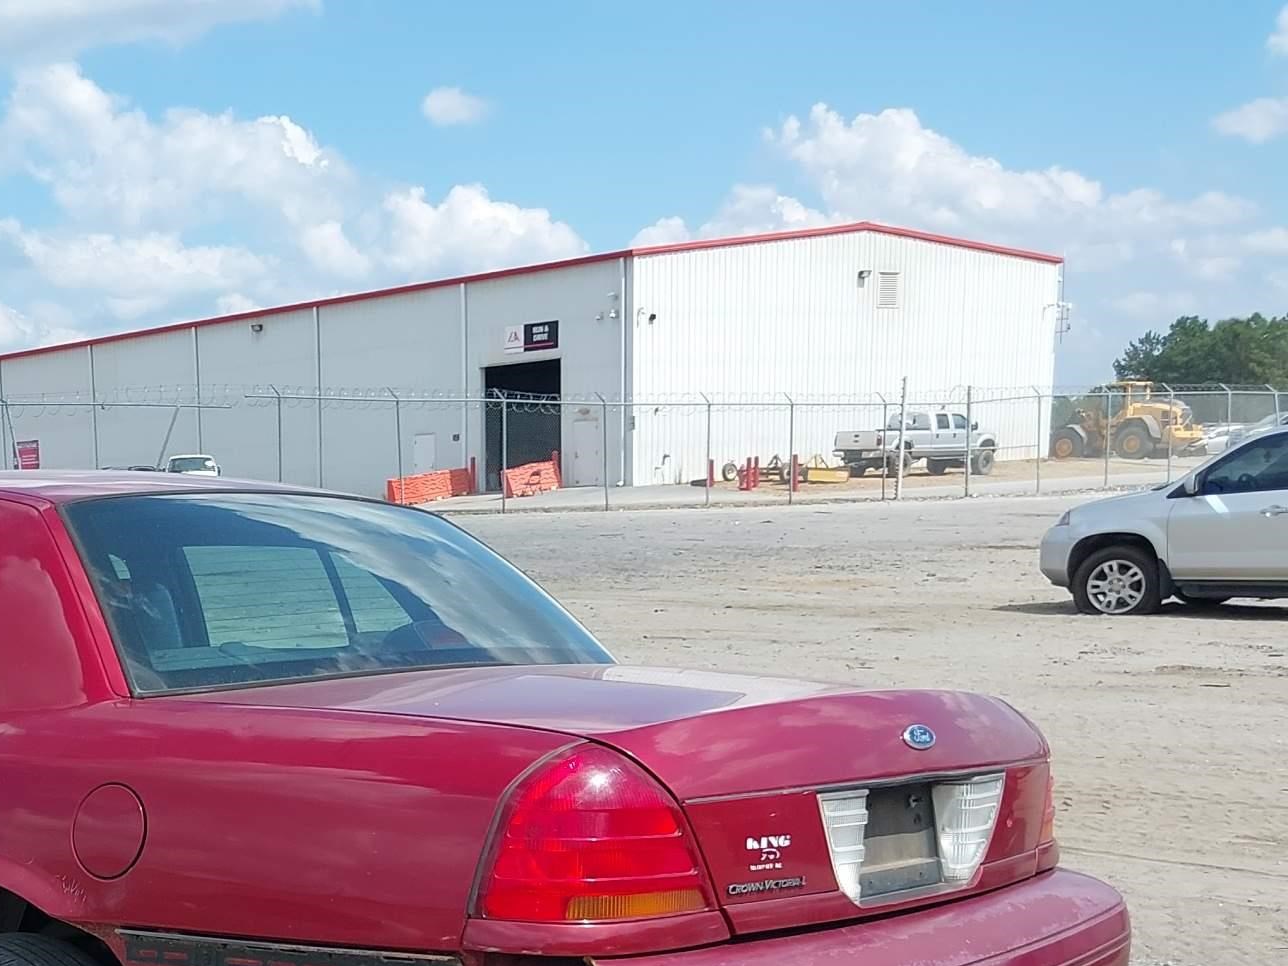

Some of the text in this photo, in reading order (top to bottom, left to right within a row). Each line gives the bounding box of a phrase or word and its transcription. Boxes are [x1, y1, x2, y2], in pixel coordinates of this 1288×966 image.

[913, 729, 931, 742] Ford
[746, 835, 791, 849] KING
[728, 882, 764, 894] CROWN
